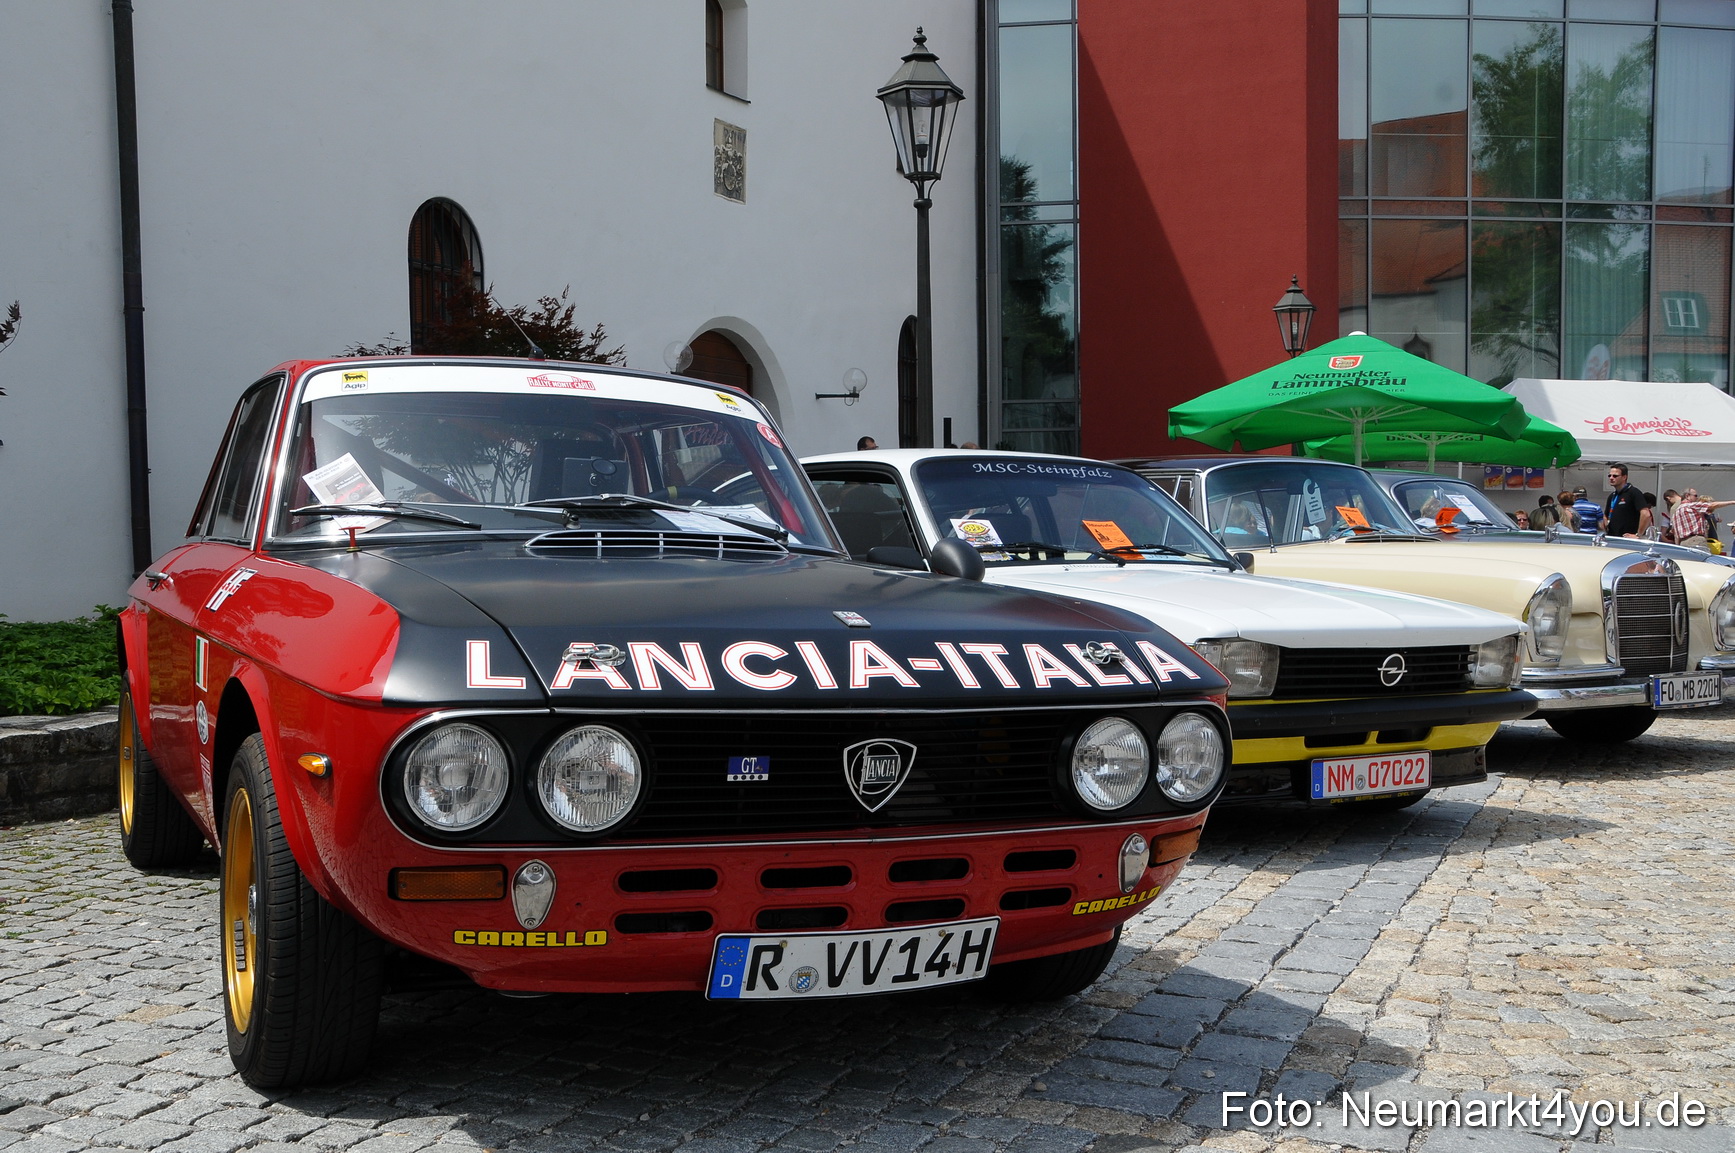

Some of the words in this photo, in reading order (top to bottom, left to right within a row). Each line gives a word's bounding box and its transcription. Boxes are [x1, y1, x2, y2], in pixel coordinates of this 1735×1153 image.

[1271, 376, 1407, 389] Lammsbräu
[1293, 370, 1391, 380] Neumarkter
[1584, 416, 1692, 434] Lehmeier's
[972, 463, 1112, 478] MSC-Steinpfalz
[1661, 681, 1674, 701] FO
[1683, 680, 1695, 700] MB
[1697, 677, 1719, 699] 220H
[865, 757, 896, 781] LANCIA
[1328, 764, 1355, 792] NM
[1368, 757, 1425, 789] 07022
[1072, 885, 1161, 916] CARELLO
[453, 930, 608, 948] CARELLO
[720, 974, 733, 988] D
[745, 944, 785, 991] R
